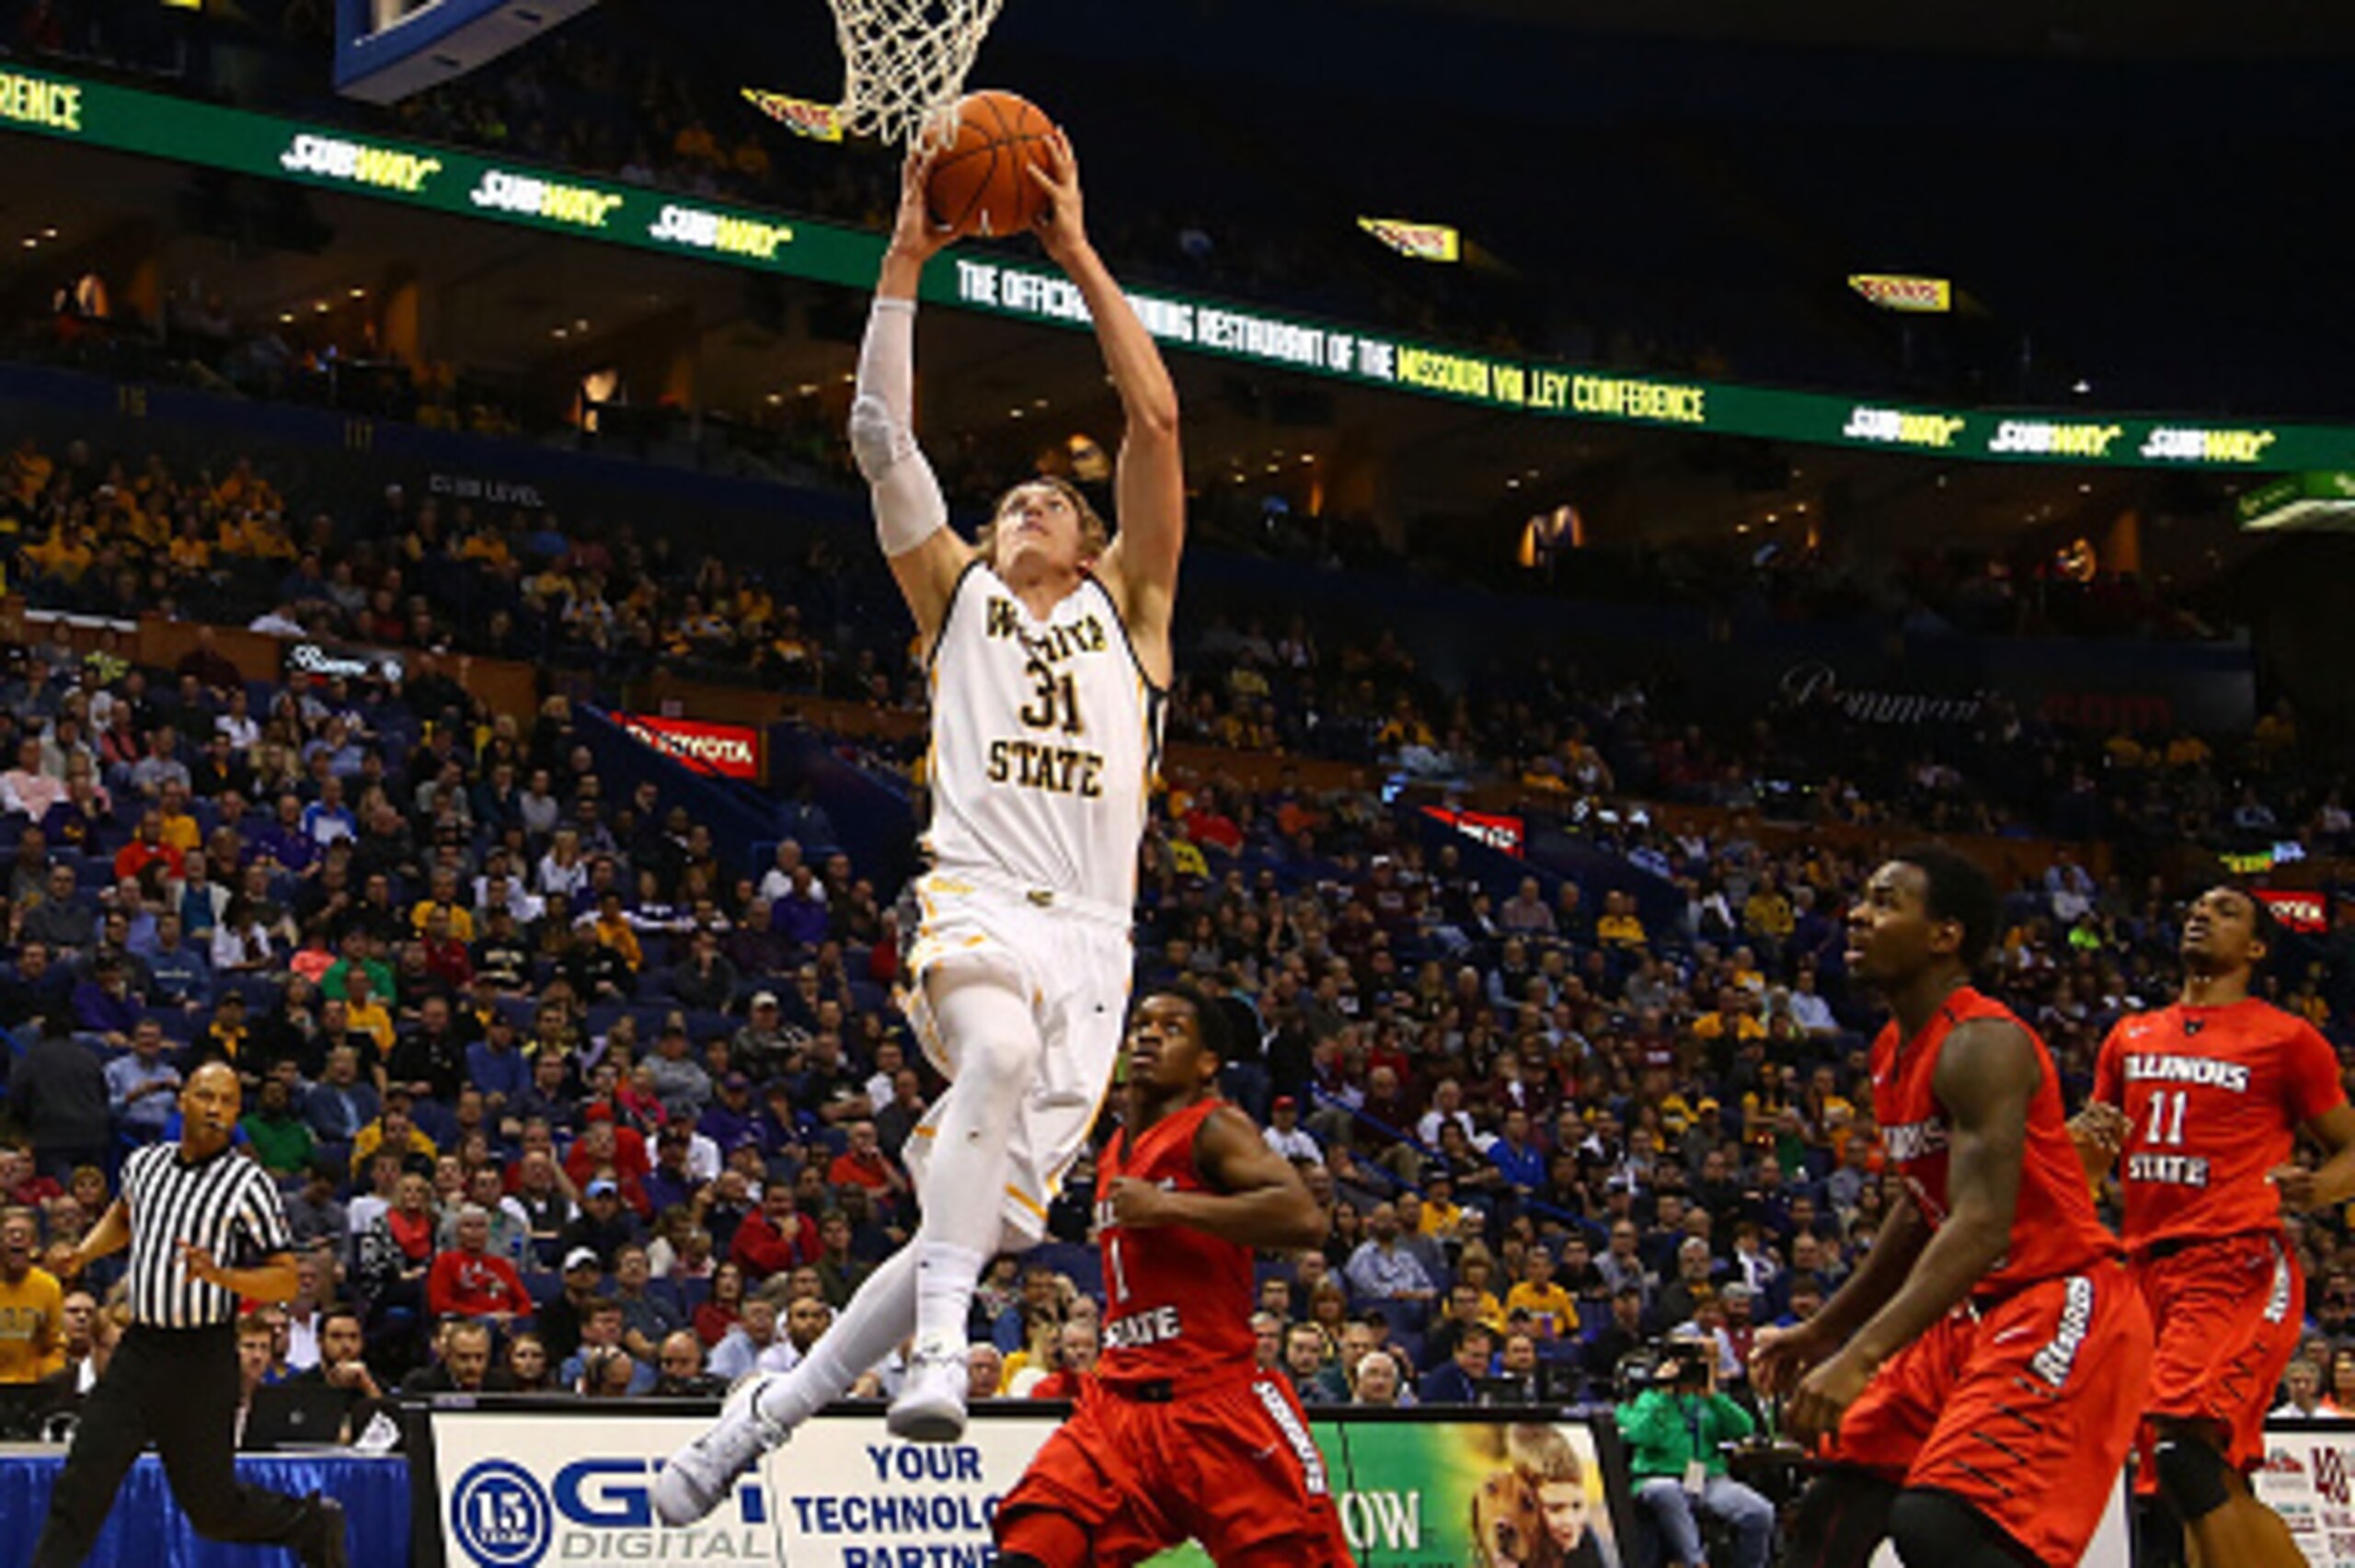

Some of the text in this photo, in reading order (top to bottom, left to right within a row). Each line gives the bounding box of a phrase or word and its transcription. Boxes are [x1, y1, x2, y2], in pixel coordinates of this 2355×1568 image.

[281, 134, 441, 191] SUBWAY
[470, 171, 622, 225] SUBWAY
[649, 204, 792, 260] SUBWAY
[957, 259, 997, 306] THE
[1198, 307, 1325, 366] RESTAURANT
[1327, 333, 1354, 372] OF
[1358, 338, 1394, 380] THE
[1397, 345, 1488, 396] MISSOURI
[1572, 374, 1705, 422] CONFERENCE
[1844, 406, 1965, 447] SUBWAY
[1989, 420, 2123, 456] SUBWAY
[2141, 427, 2276, 462] SUBWAY
[1021, 658, 1084, 736] 31
[986, 738, 1106, 798] STATE
[2125, 1054, 2251, 1093] ILLINOIS
[2145, 1089, 2188, 1146] 11
[2128, 1152, 2210, 1188] STATE
[867, 1445, 983, 1482] YOUR
[476, 1491, 527, 1530] 15
[559, 1530, 771, 1560] DIGITAL
